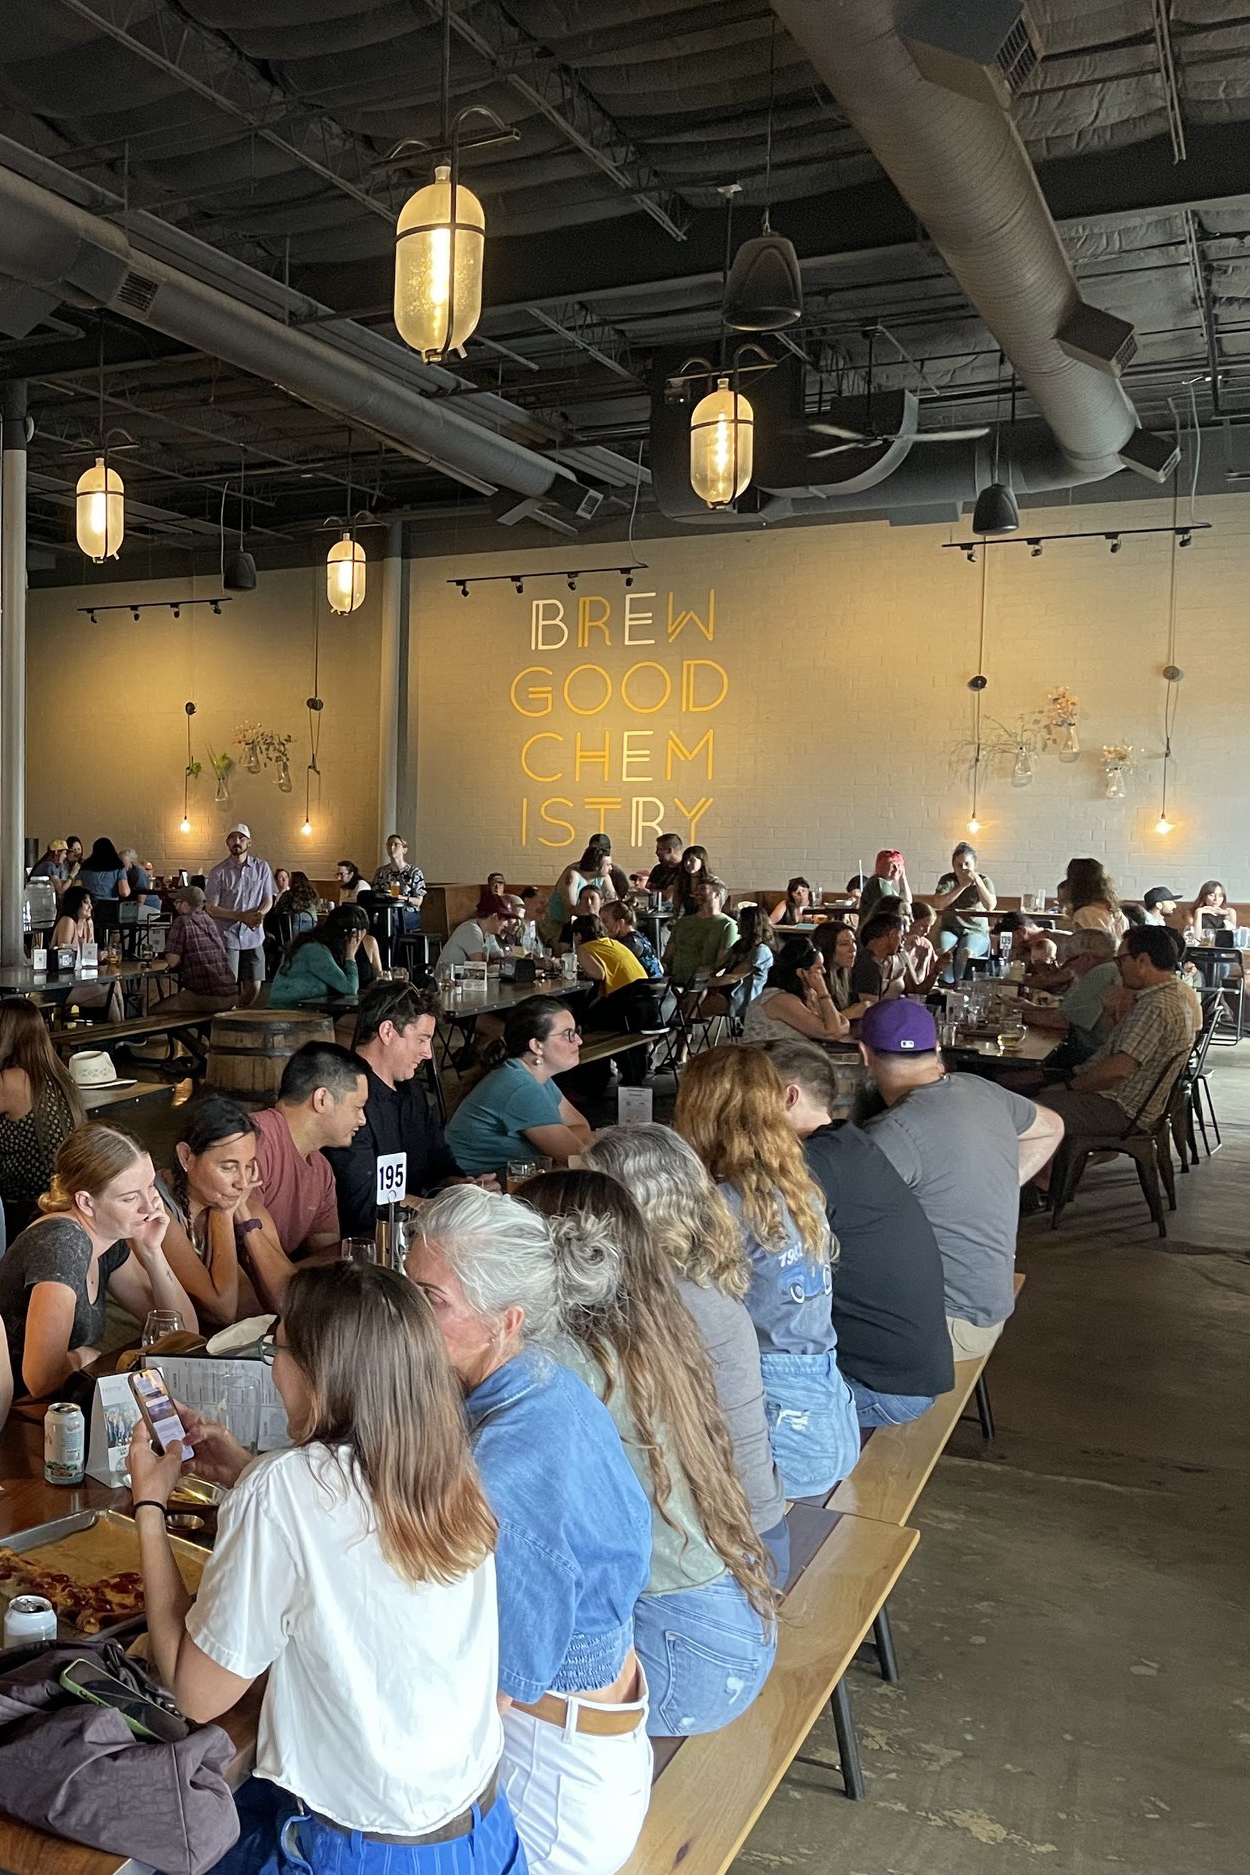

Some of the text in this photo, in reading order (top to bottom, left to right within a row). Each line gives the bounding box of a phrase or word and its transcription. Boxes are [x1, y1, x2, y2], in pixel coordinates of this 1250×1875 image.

[531, 589, 715, 650] BREW
[510, 659, 729, 717] GOOD
[521, 728, 714, 782] CHEM
[521, 797, 714, 848] ISTRY
[379, 1163, 403, 1190] 195
